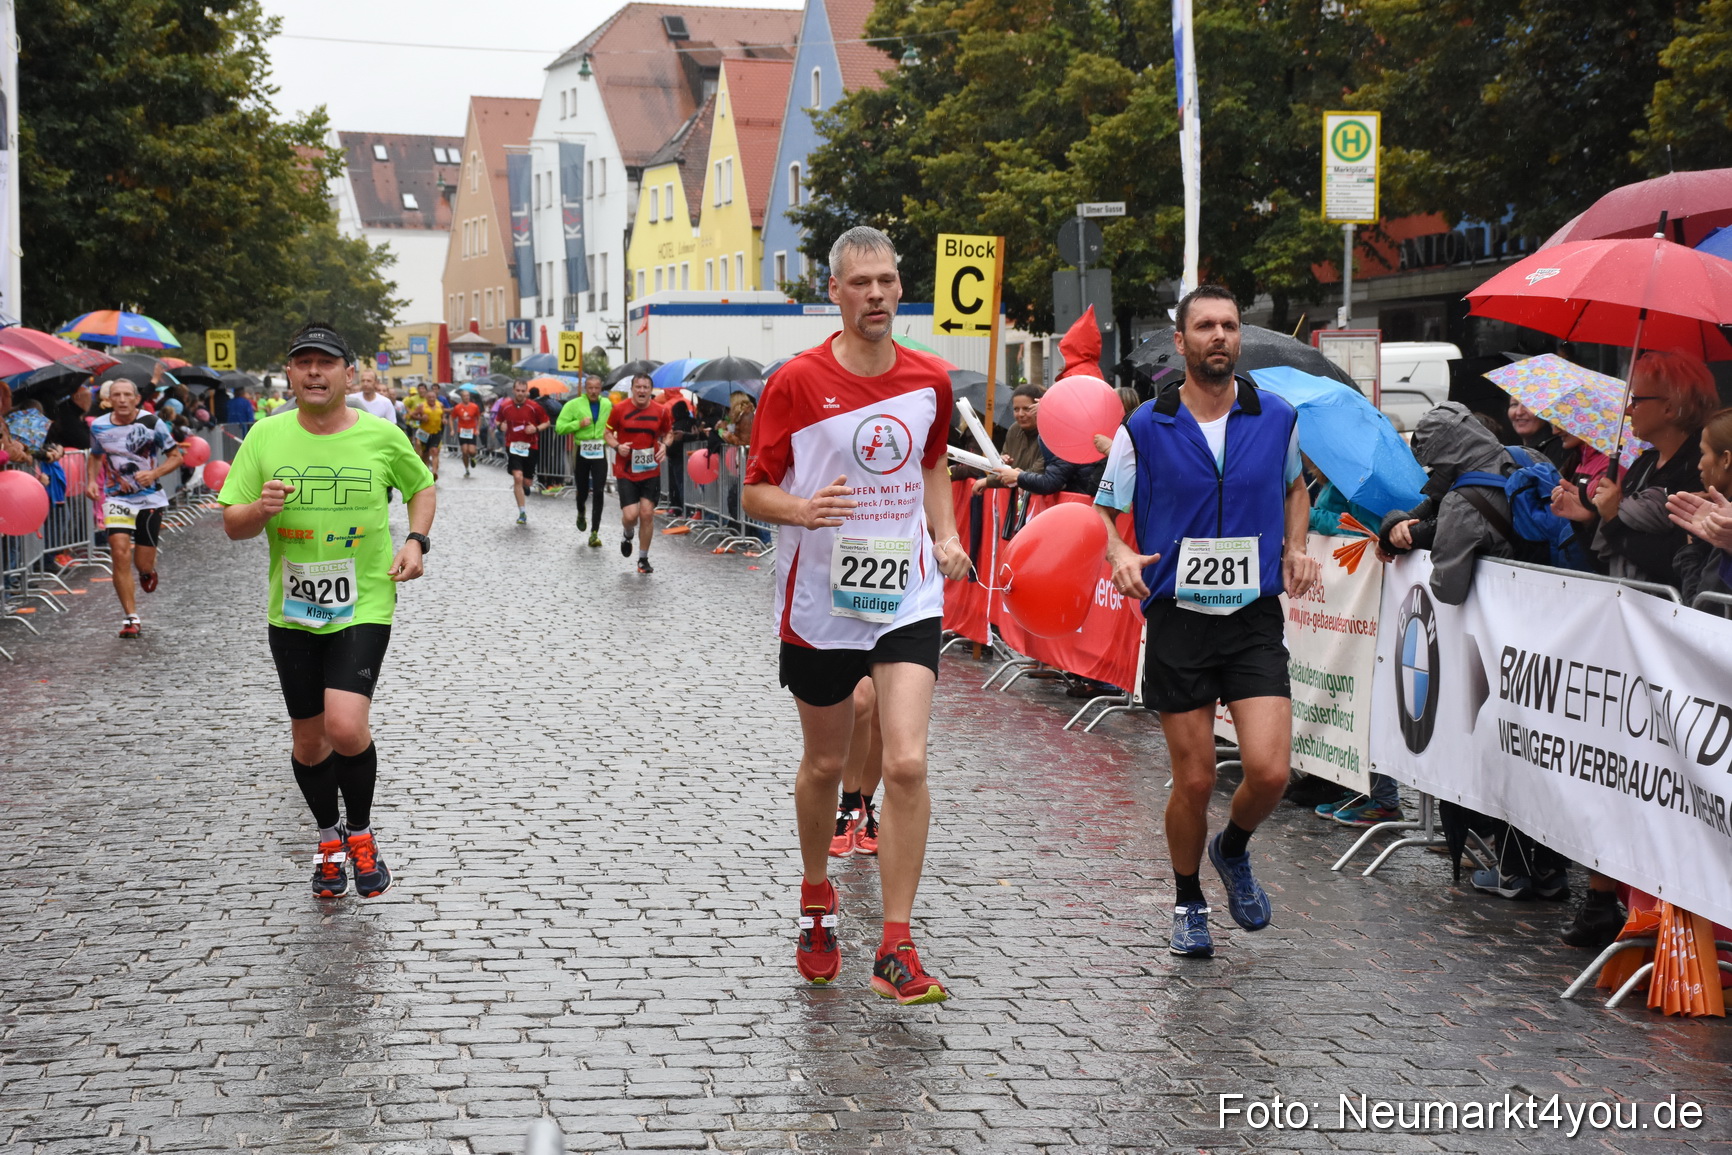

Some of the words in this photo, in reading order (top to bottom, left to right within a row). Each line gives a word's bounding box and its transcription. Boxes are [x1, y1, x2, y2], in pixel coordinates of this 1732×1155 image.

[1342, 130, 1361, 152] H
[1334, 166, 1368, 175] Marktplatz
[1105, 205, 1123, 213] Gasse
[945, 239, 996, 259] Block
[951, 265, 985, 315] C
[209, 331, 231, 340] Block
[561, 332, 580, 340] Block
[214, 343, 228, 361] D
[564, 343, 577, 362] D
[583, 443, 602, 451] 2242
[850, 486, 876, 495] UFEN
[881, 485, 900, 494] MIT
[857, 499, 878, 508] Heck
[873, 539, 911, 552] BOCK
[1215, 540, 1252, 551] BOCK
[309, 562, 349, 574] BOCK
[840, 556, 909, 591] 2226
[1185, 556, 1249, 586] 2281
[289, 575, 350, 604] 2920
[853, 596, 900, 613] Rüdiger
[1193, 593, 1243, 604] Bernhard
[306, 606, 334, 620] Klaus
[1399, 588, 1436, 646] BMW
[1291, 699, 1354, 733] ausmeisterdienst
[1500, 645, 1563, 714] BMW
[1564, 661, 1732, 775] EFFICIENTD
[1498, 717, 1566, 773] WENIGER
[1569, 740, 1689, 815] VERBRAUCH.
[1688, 779, 1731, 838] MEHR
